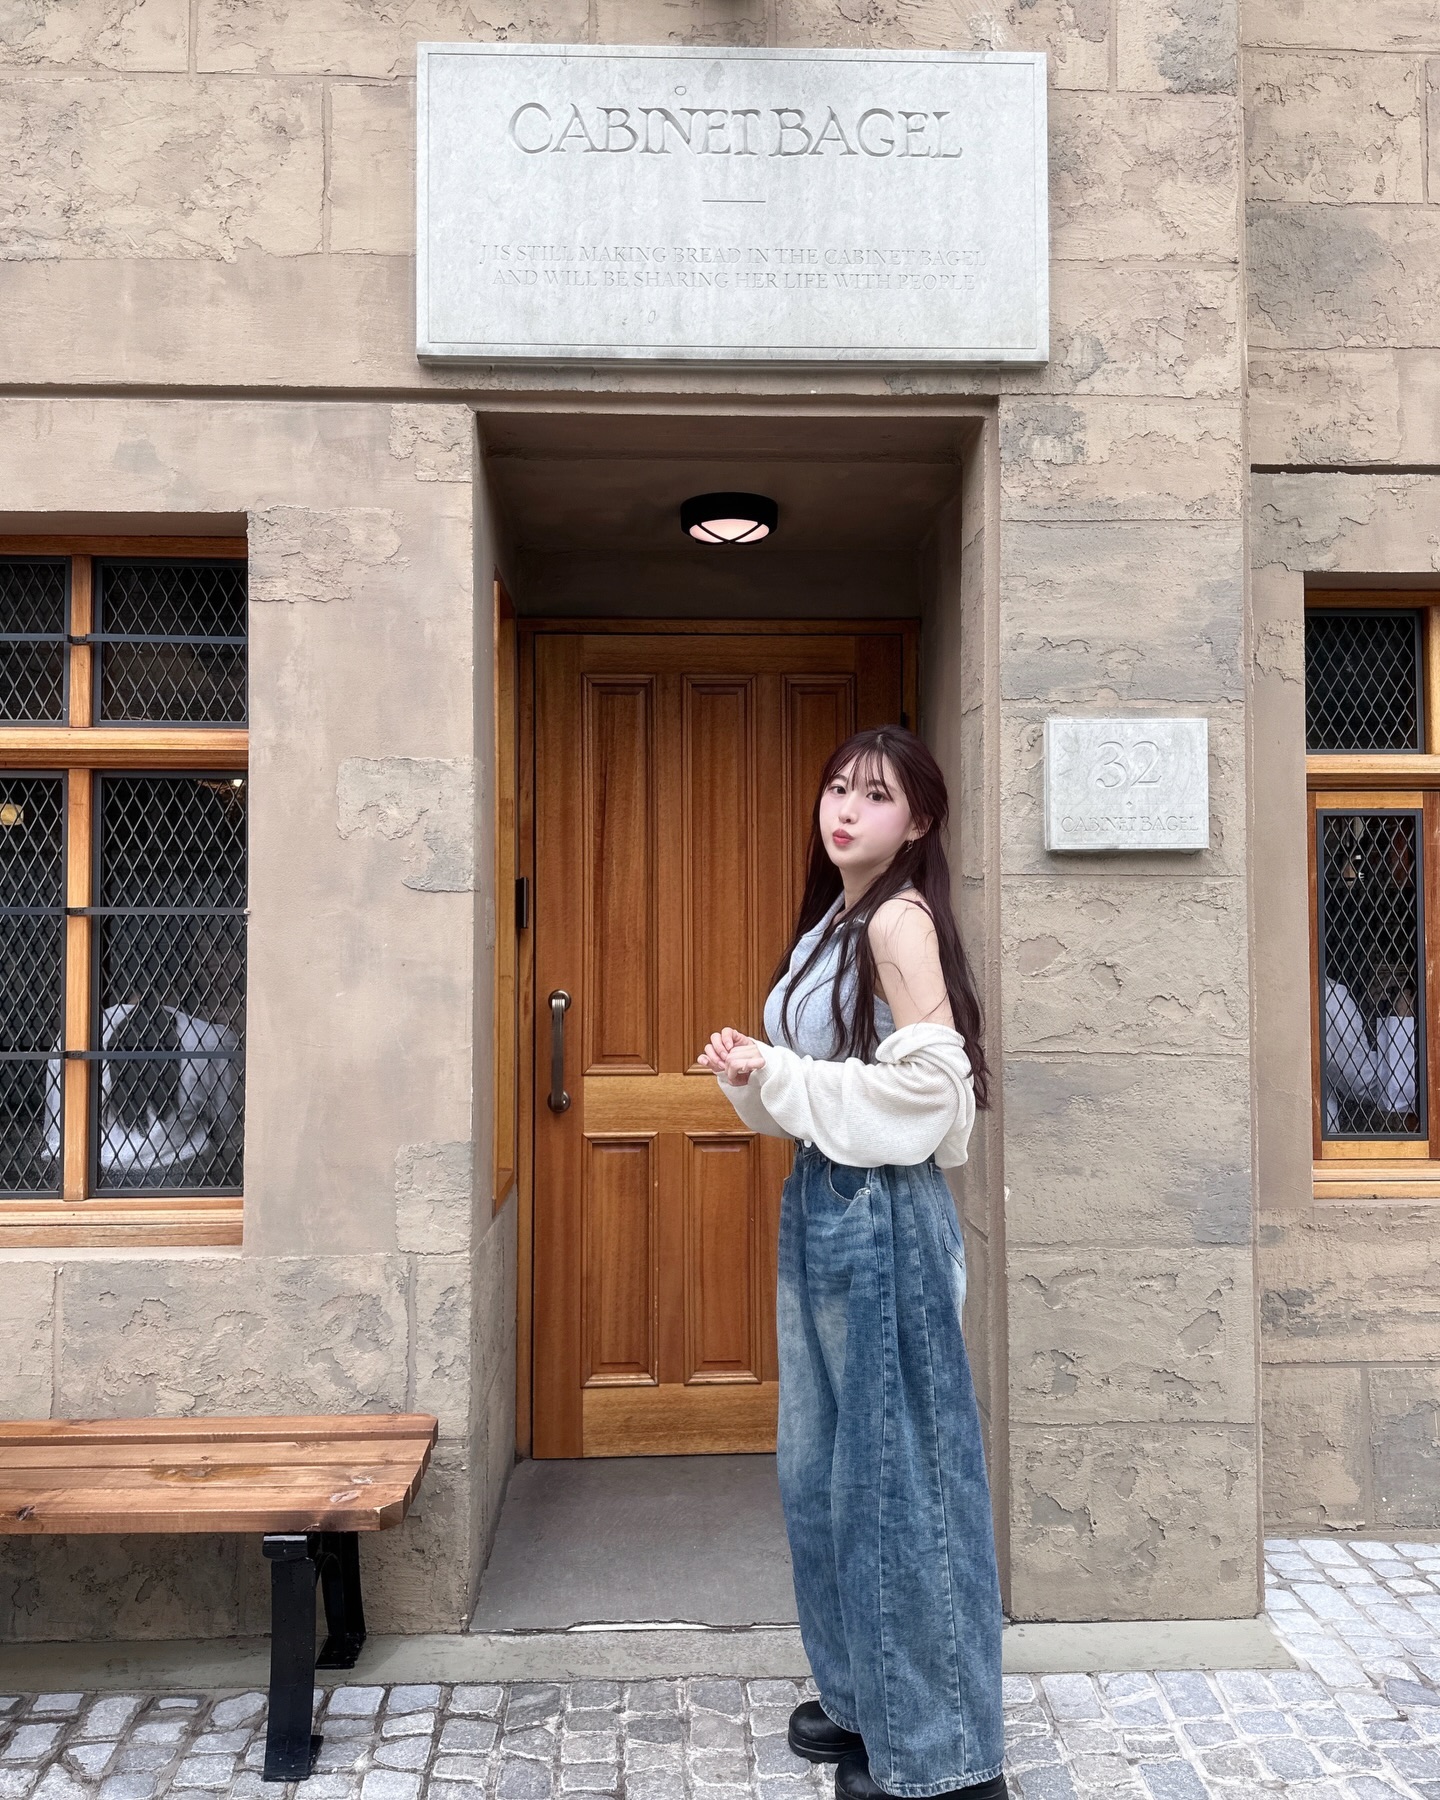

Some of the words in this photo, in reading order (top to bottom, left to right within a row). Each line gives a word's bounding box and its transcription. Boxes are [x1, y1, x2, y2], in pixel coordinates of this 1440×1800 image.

[509, 102, 763, 156] CABINET
[768, 104, 963, 160] BAGEL
[492, 244, 511, 261] IS
[516, 245, 574, 262] STILL
[578, 246, 667, 263] MAKING
[672, 247, 741, 264] BREAD
[747, 248, 769, 264] IN
[774, 248, 819, 264] THE
[824, 249, 916, 265] CABINET
[919, 250, 987, 267] BAGEL
[492, 269, 538, 286] AND
[543, 270, 598, 287] WILL
[603, 271, 629, 287] BE
[633, 271, 729, 288] SHARING
[735, 272, 778, 289] HER
[783, 273, 828, 289] LIFE
[833, 273, 892, 290] WITH
[897, 274, 976, 291] PEOPLE
[1095, 740, 1162, 788] 32
[1060, 815, 1137, 833] CABINET
[1139, 815, 1200, 832] BAGEL
